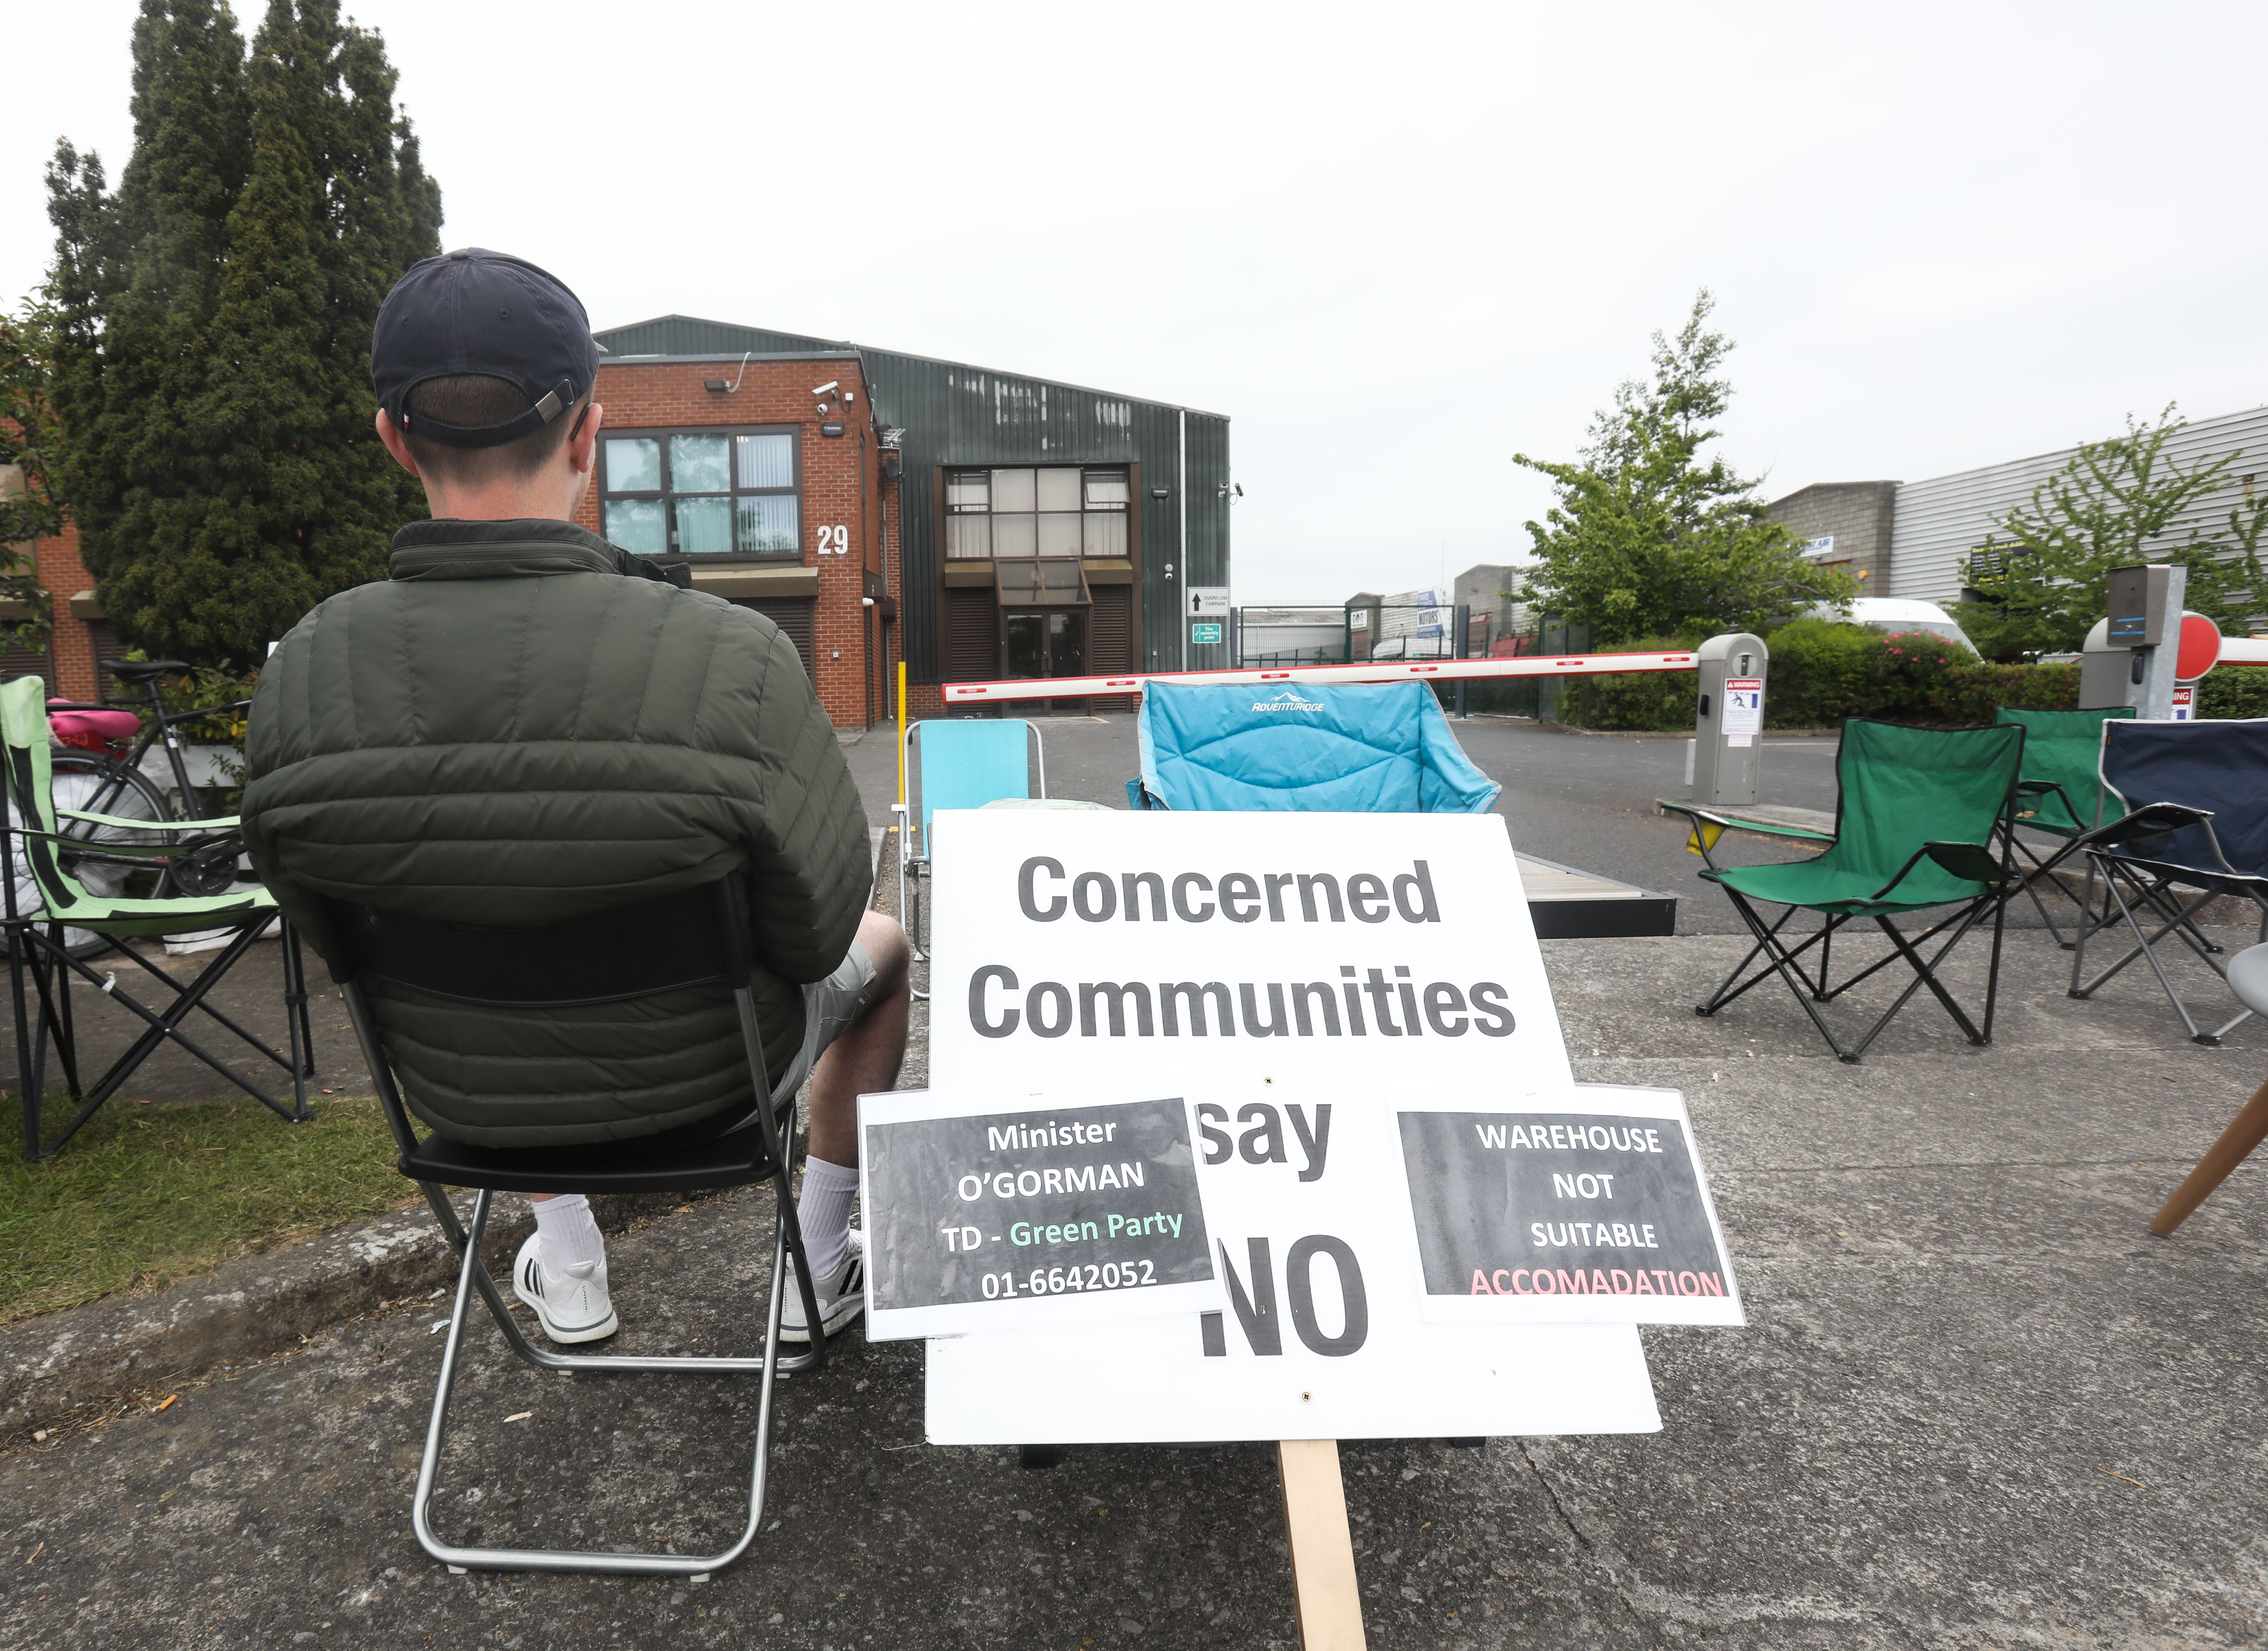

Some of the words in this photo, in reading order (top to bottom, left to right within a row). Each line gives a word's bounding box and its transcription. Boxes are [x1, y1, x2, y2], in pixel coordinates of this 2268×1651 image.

[817, 525, 848, 554] 29
[1418, 610, 1438, 625] MOTORS
[1252, 702, 1325, 712] ADVENTURIDGE
[1018, 856, 1441, 923] Concerned
[969, 965, 1516, 1038] Communities
[987, 1121, 1117, 1151] Minister
[1195, 1103, 1331, 1182] say
[1475, 1124, 1663, 1153] WAREHOUSE
[958, 1162, 1144, 1202] O'GORMAN
[1552, 1173, 1614, 1199] NOT
[942, 1226, 982, 1253] TD
[1010, 1222, 1099, 1247] Green
[1107, 1211, 1183, 1239] Party
[1531, 1222, 1659, 1248] SUITABLE
[981, 1259, 1157, 1299] 01-6642052
[1470, 1269, 1724, 1296] ACCOMADATION
[1200, 1234, 1368, 1357] NO
